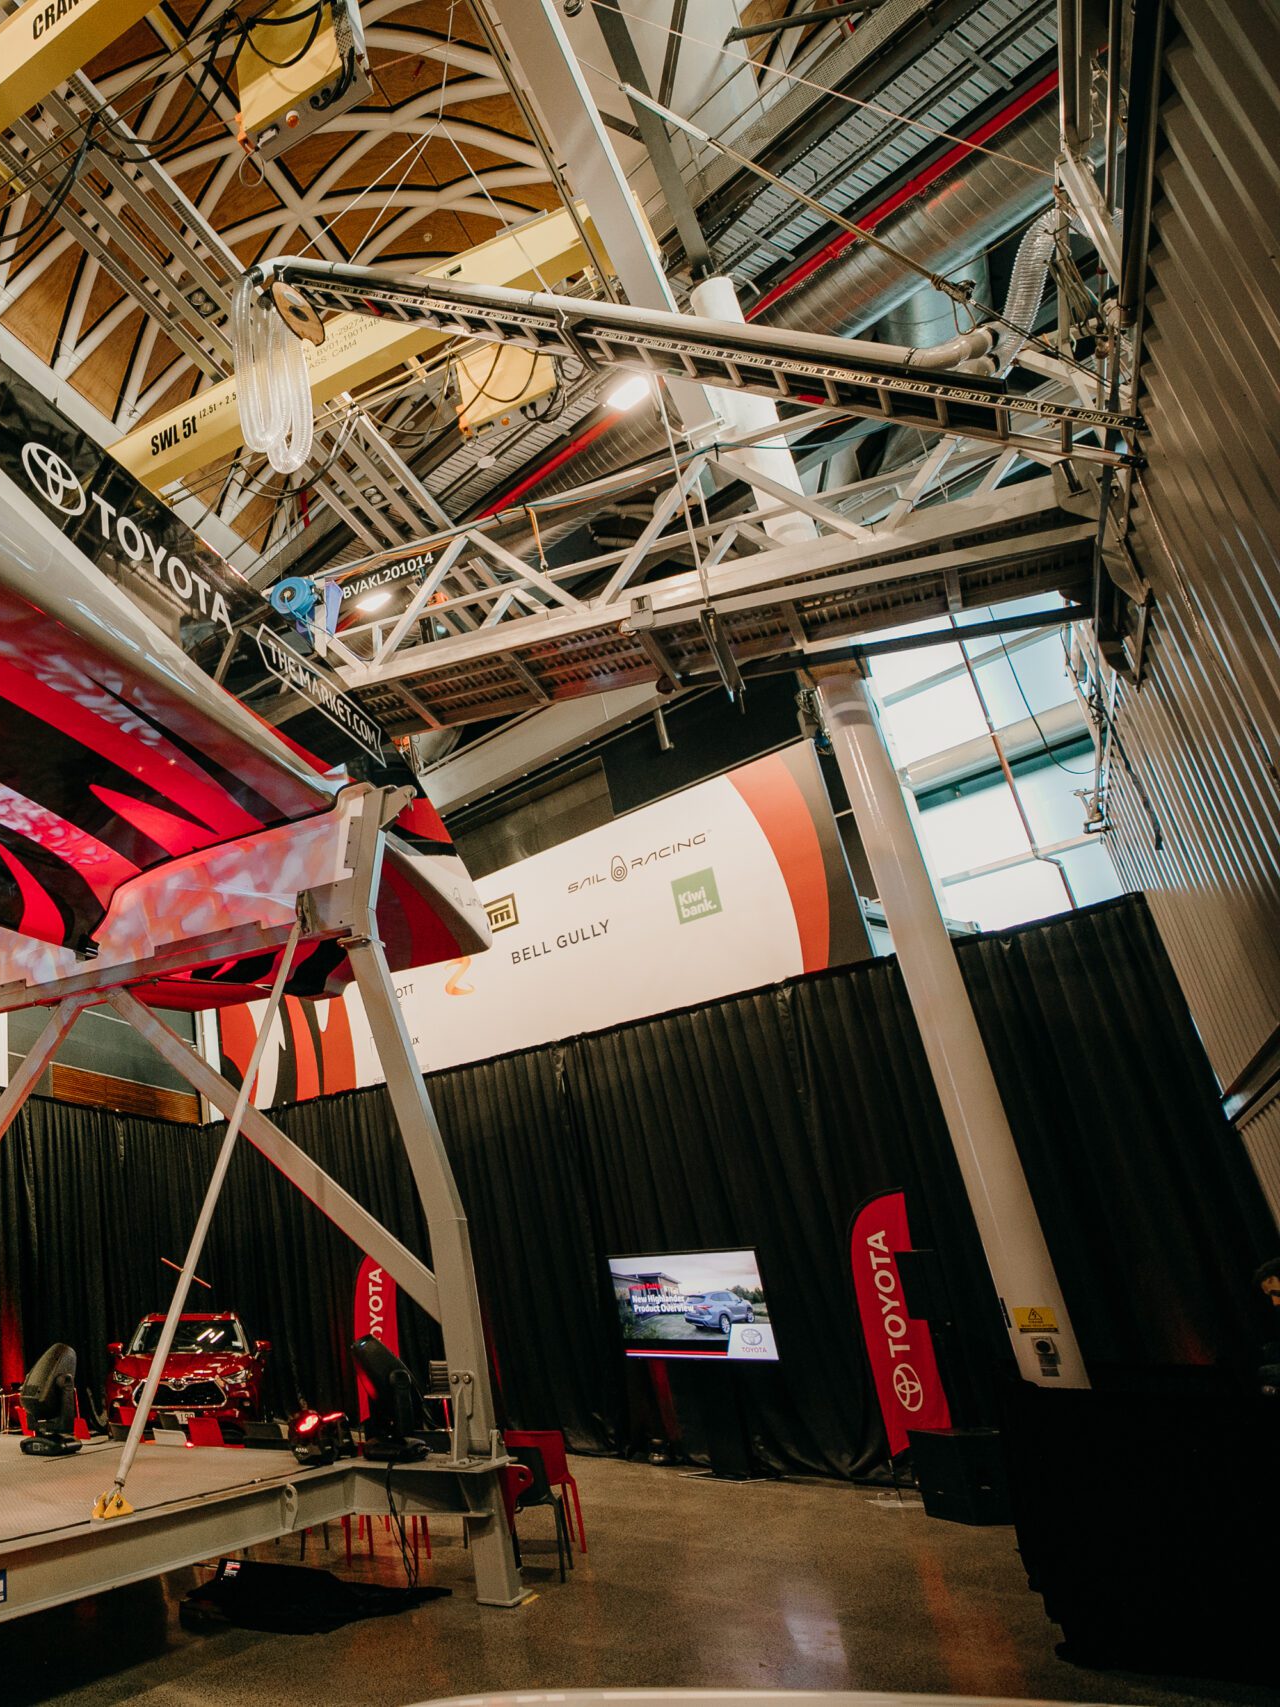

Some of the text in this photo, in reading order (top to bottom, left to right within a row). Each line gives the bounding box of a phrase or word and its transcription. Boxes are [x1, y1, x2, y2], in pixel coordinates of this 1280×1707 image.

[1009, 399, 1056, 415] ULRICH
[151, 423, 181, 456] SWL
[182, 415, 198, 439] 5t
[91, 490, 234, 636] TOYOTA
[342, 551, 434, 600] BVAKL201014
[267, 638, 380, 751] THEMARKET.COM
[568, 832, 706, 894] SAIL RACING
[677, 886, 706, 907] Kiwi
[680, 898, 718, 919] bank.
[511, 919, 610, 965] BELL GULLY
[367, 1267, 384, 1342] OYOTA
[631, 1294, 685, 1306] New Highlander
[634, 1303, 695, 1313] Product Overview
[866, 1229, 911, 1359] TOYOTA
